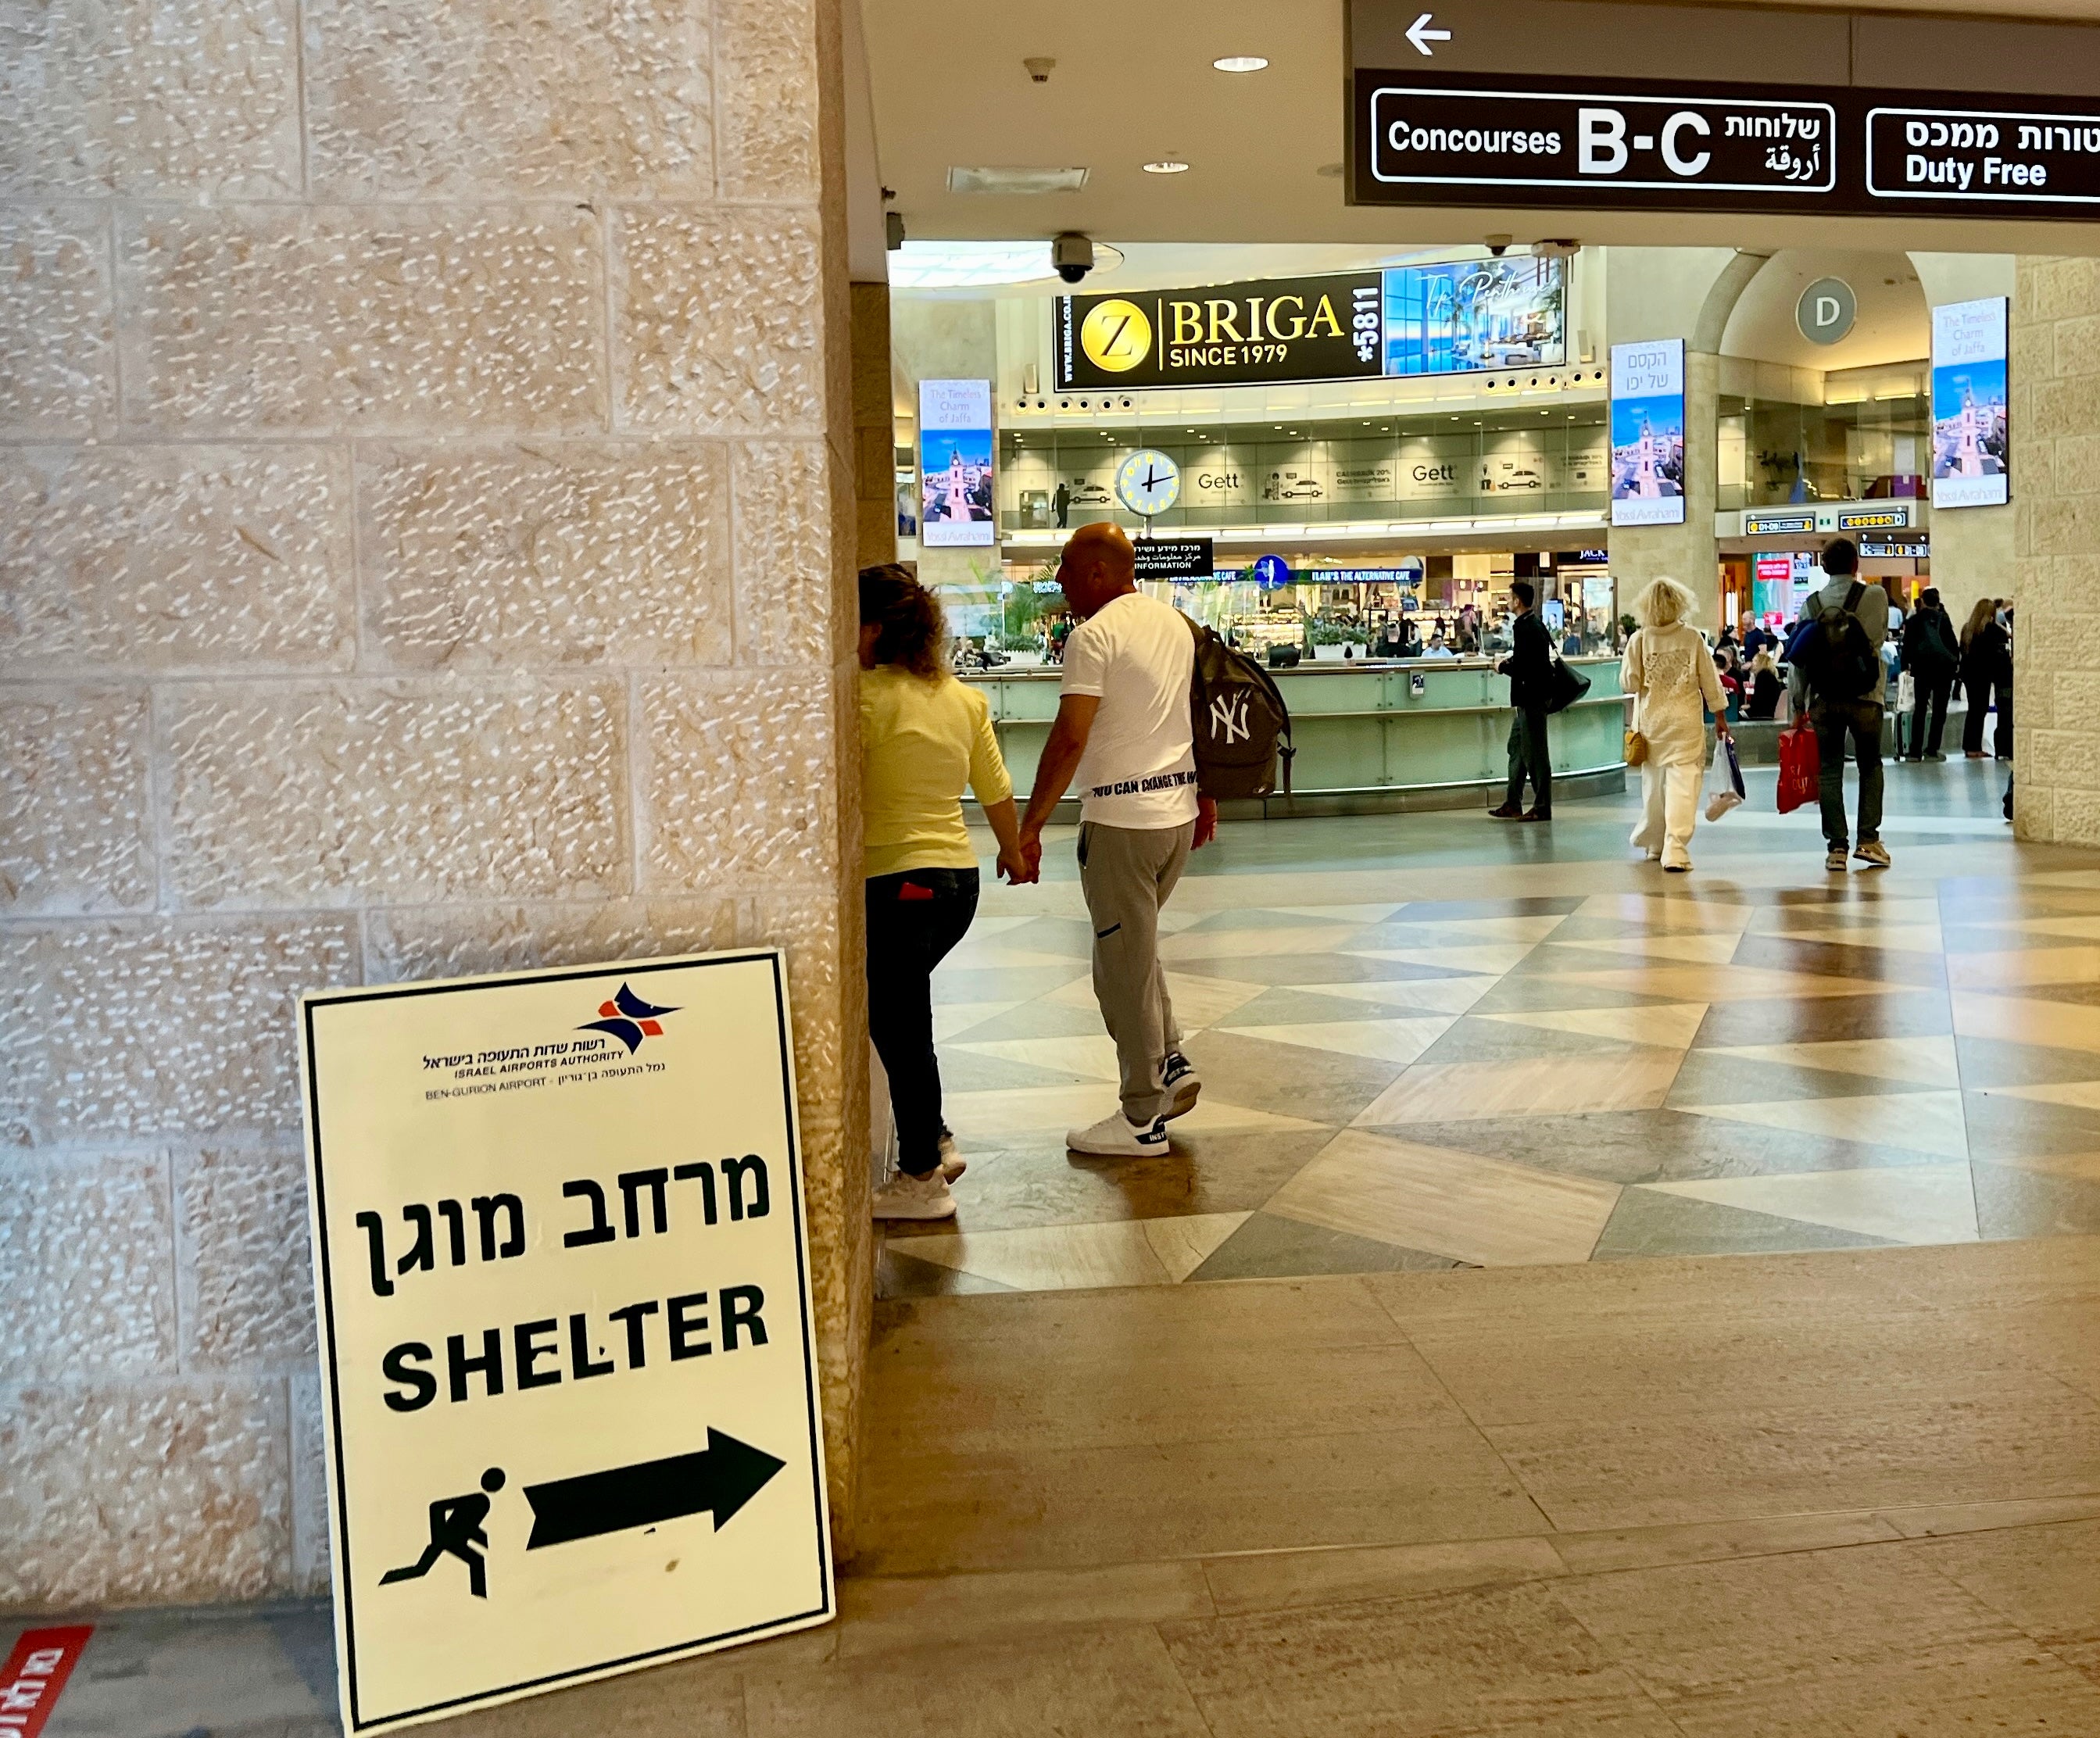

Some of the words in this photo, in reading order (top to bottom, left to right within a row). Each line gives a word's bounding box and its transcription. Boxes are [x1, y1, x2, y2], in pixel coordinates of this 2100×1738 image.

[1724, 113, 1820, 140] שלוחות
[1905, 121, 1999, 148] ממכס
[1388, 120, 1562, 155] Concourses
[1578, 107, 1712, 177] B-C
[2017, 125, 2100, 152] טורות
[1765, 143, 1821, 181] أروقة
[1905, 154, 1974, 190] Duty
[1984, 157, 2047, 186] Free
[1415, 274, 1453, 318] Tp
[1169, 294, 1345, 345] BRIGA
[1816, 296, 1841, 327] D
[1944, 314, 1959, 328] The
[1962, 311, 1997, 325] Timeless
[1100, 315, 1134, 356] Z
[1953, 328, 1984, 342] Charm
[1170, 346, 1236, 367] SINCE
[1241, 344, 1287, 364] 1979
[1952, 345, 1962, 357] of
[1963, 342, 1986, 356] Jaffa
[1628, 351, 1667, 370] הקסם
[1626, 374, 1644, 391] יפו
[1648, 373, 1669, 389] של
[932, 390, 946, 399] The
[947, 390, 982, 399] Timeless
[939, 401, 970, 411] Charm
[939, 413, 949, 424] of
[950, 413, 971, 424] Jaffa
[1198, 473, 1240, 490] Gett
[1413, 464, 1456, 481] Gett
[1637, 506, 1680, 520] Avrahami
[1340, 570, 1354, 581] THE
[1354, 570, 1395, 581] ALTERNATIVE
[1395, 570, 1411, 581] CAFE
[1210, 688, 1252, 744] NY
[1114, 780, 1139, 796] CAN
[1141, 774, 1173, 792] CHANGE
[1173, 771, 1186, 786] THE
[478, 1046, 529, 1064] התעופה
[533, 1042, 568, 1057] שדות
[571, 1038, 606, 1053] רשות
[423, 1053, 474, 1070] בישראל
[454, 1067, 496, 1079] ISRAEL
[499, 1057, 558, 1075] AIRPORTS
[560, 1050, 624, 1067] AUTHORITY
[645, 1061, 667, 1074] נמל
[601, 1064, 643, 1079] התעופה
[425, 1082, 496, 1101] BEN-GURION
[499, 1076, 547, 1092] AIRPORT
[562, 1153, 771, 1249] מרחב
[356, 1193, 526, 1297] מוגן
[382, 1284, 769, 1413] SHELTER
